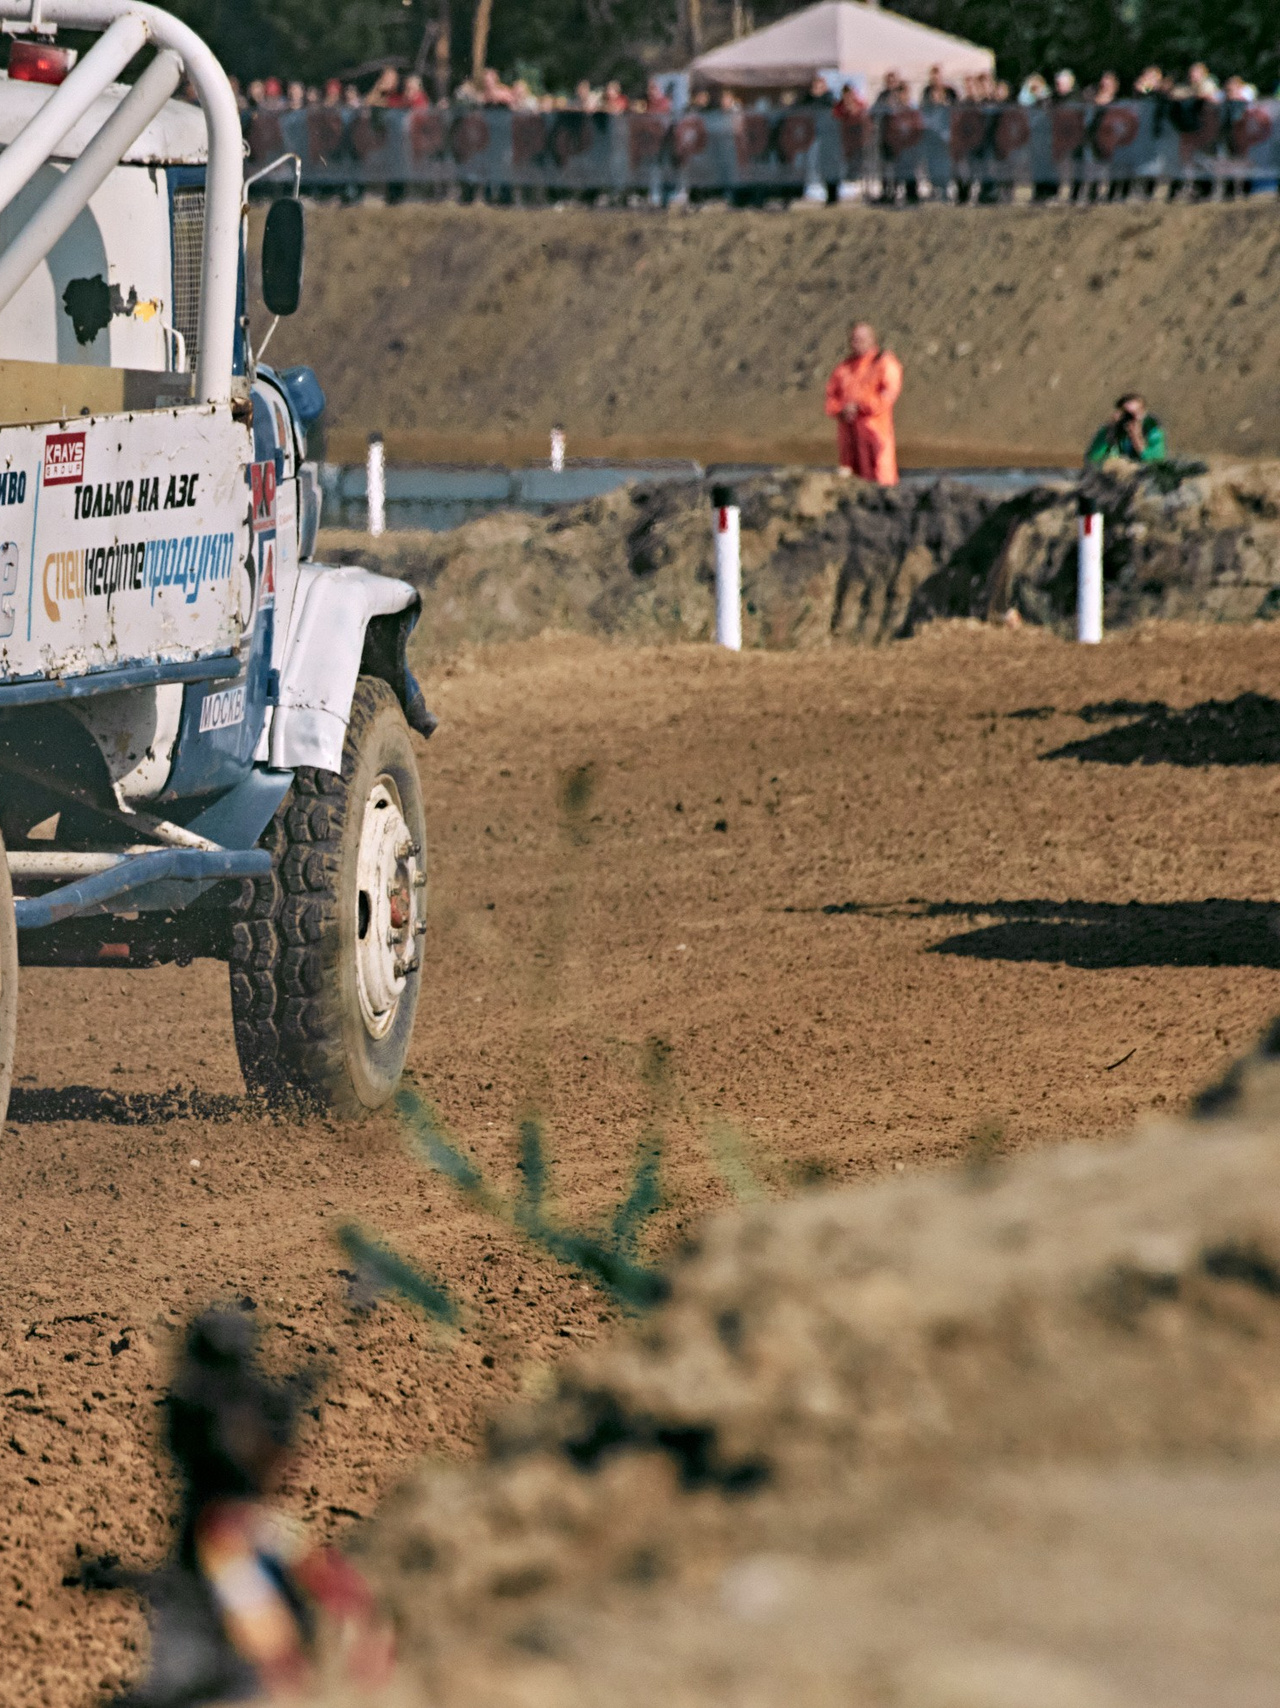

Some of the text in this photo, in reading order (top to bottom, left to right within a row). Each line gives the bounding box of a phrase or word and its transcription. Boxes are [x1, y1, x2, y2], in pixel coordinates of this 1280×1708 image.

[45, 441, 84, 464] KRAYS
[46, 463, 81, 477] GROUP
[74, 473, 200, 520] ТОЛЬКО НА АЗС
